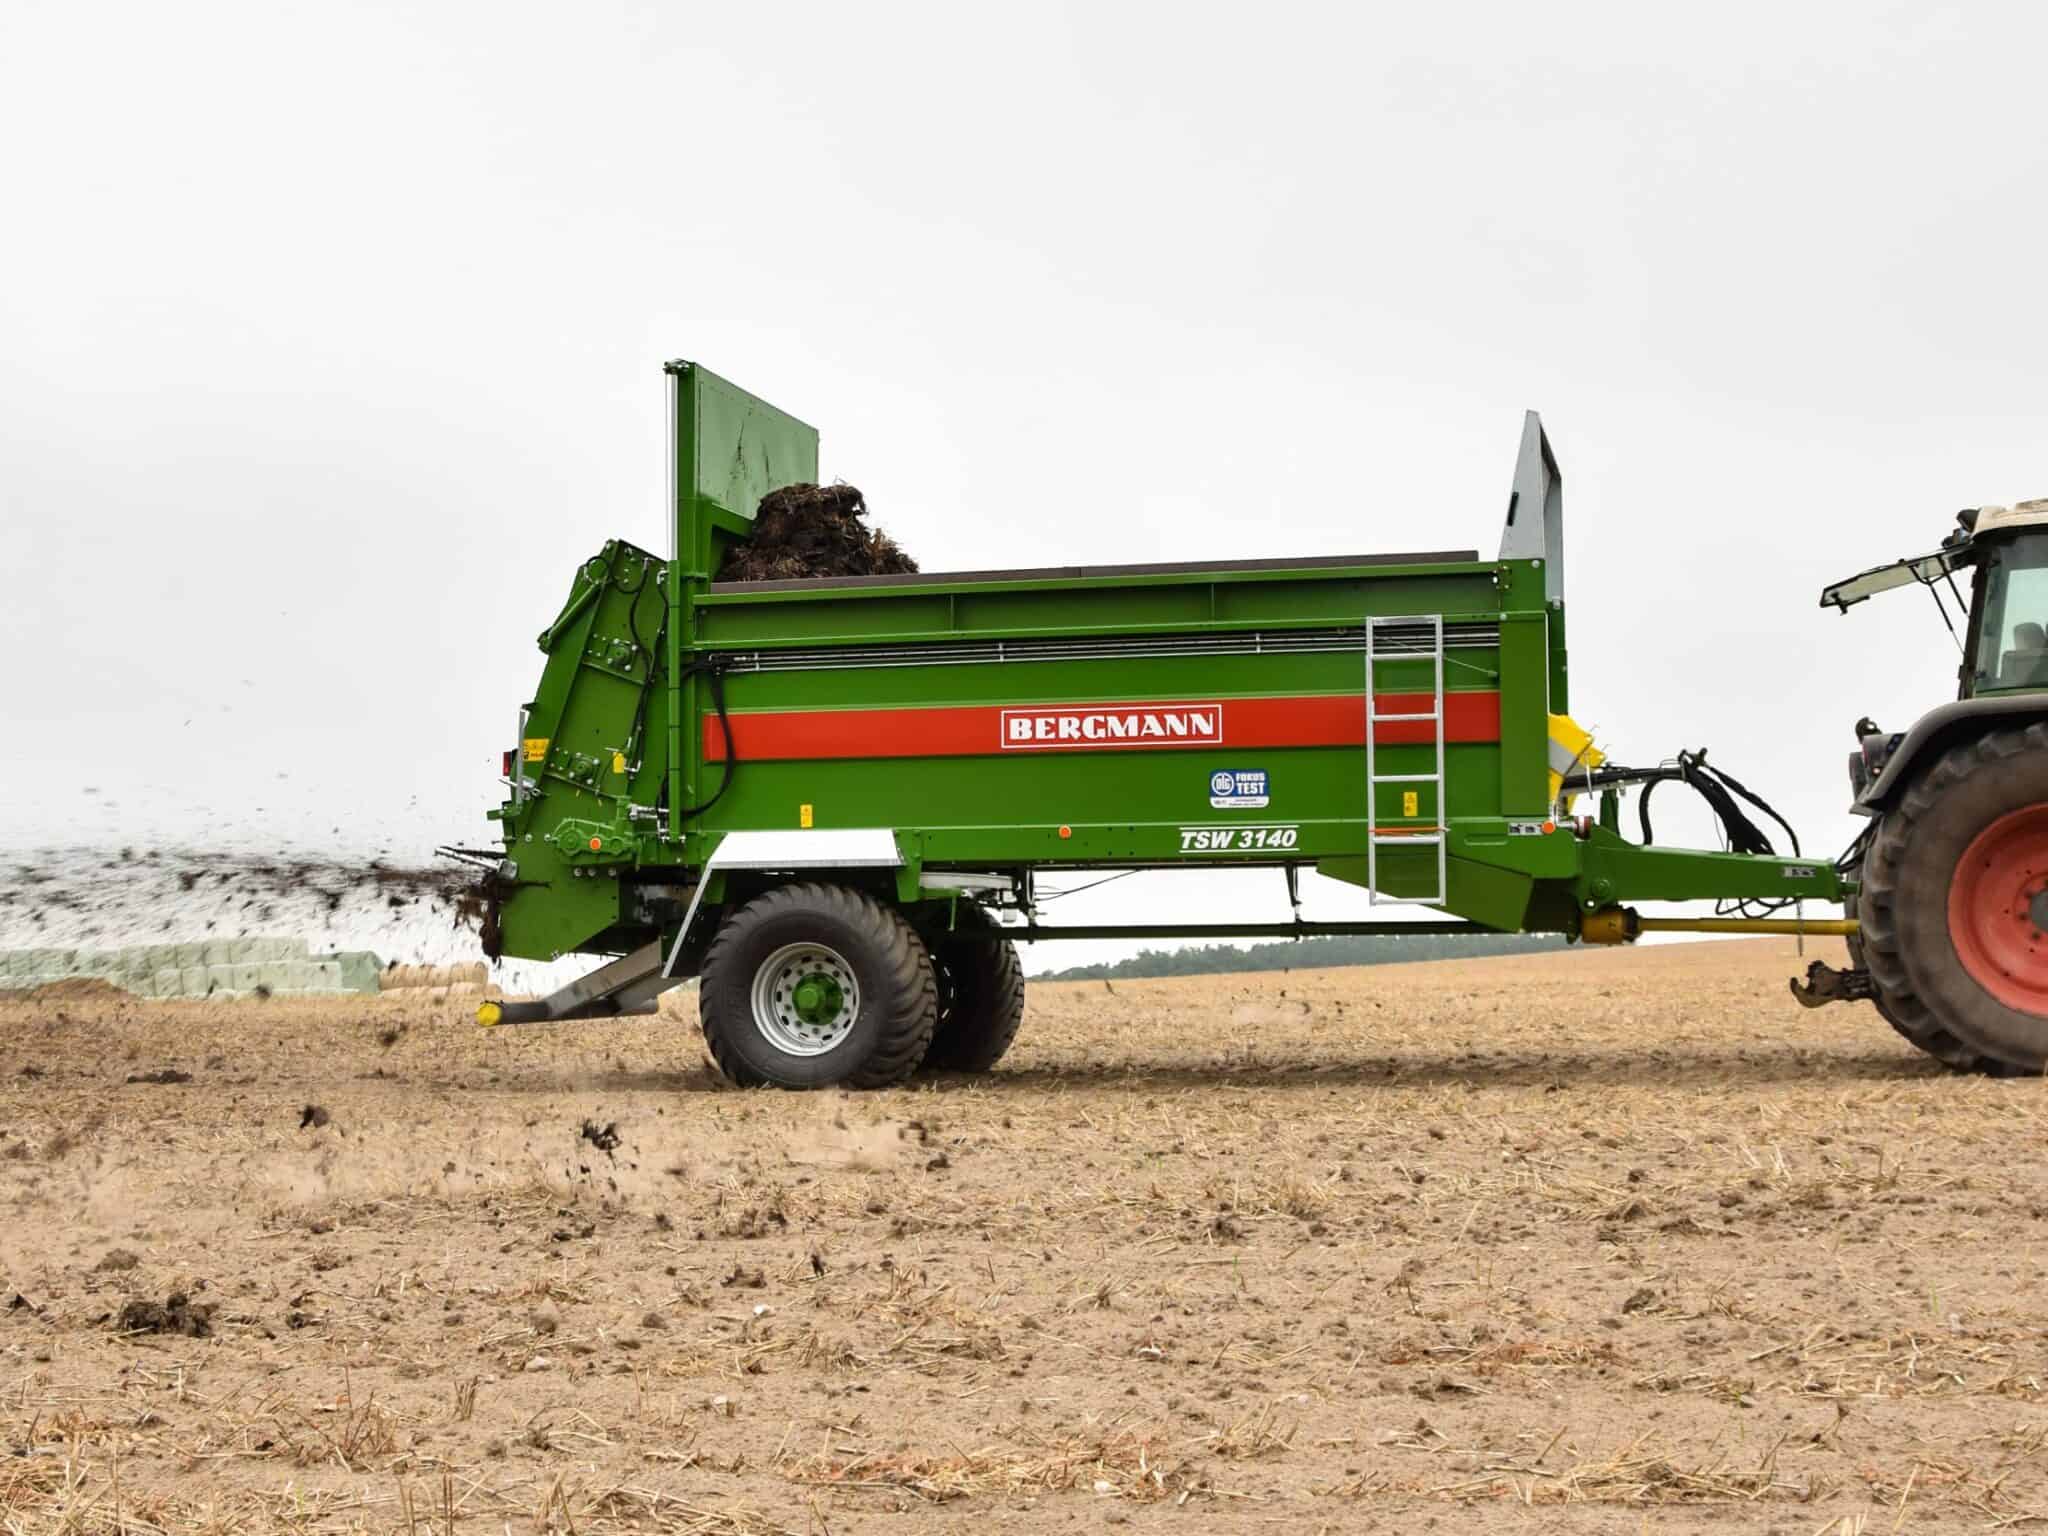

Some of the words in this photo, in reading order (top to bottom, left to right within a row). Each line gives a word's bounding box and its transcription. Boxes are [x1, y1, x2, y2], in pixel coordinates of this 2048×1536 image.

[1008, 713, 1214, 740] BERGMANN
[1236, 782, 1265, 795] TEST
[1181, 831, 1234, 849] TSW
[1238, 829, 1297, 848] 3140
